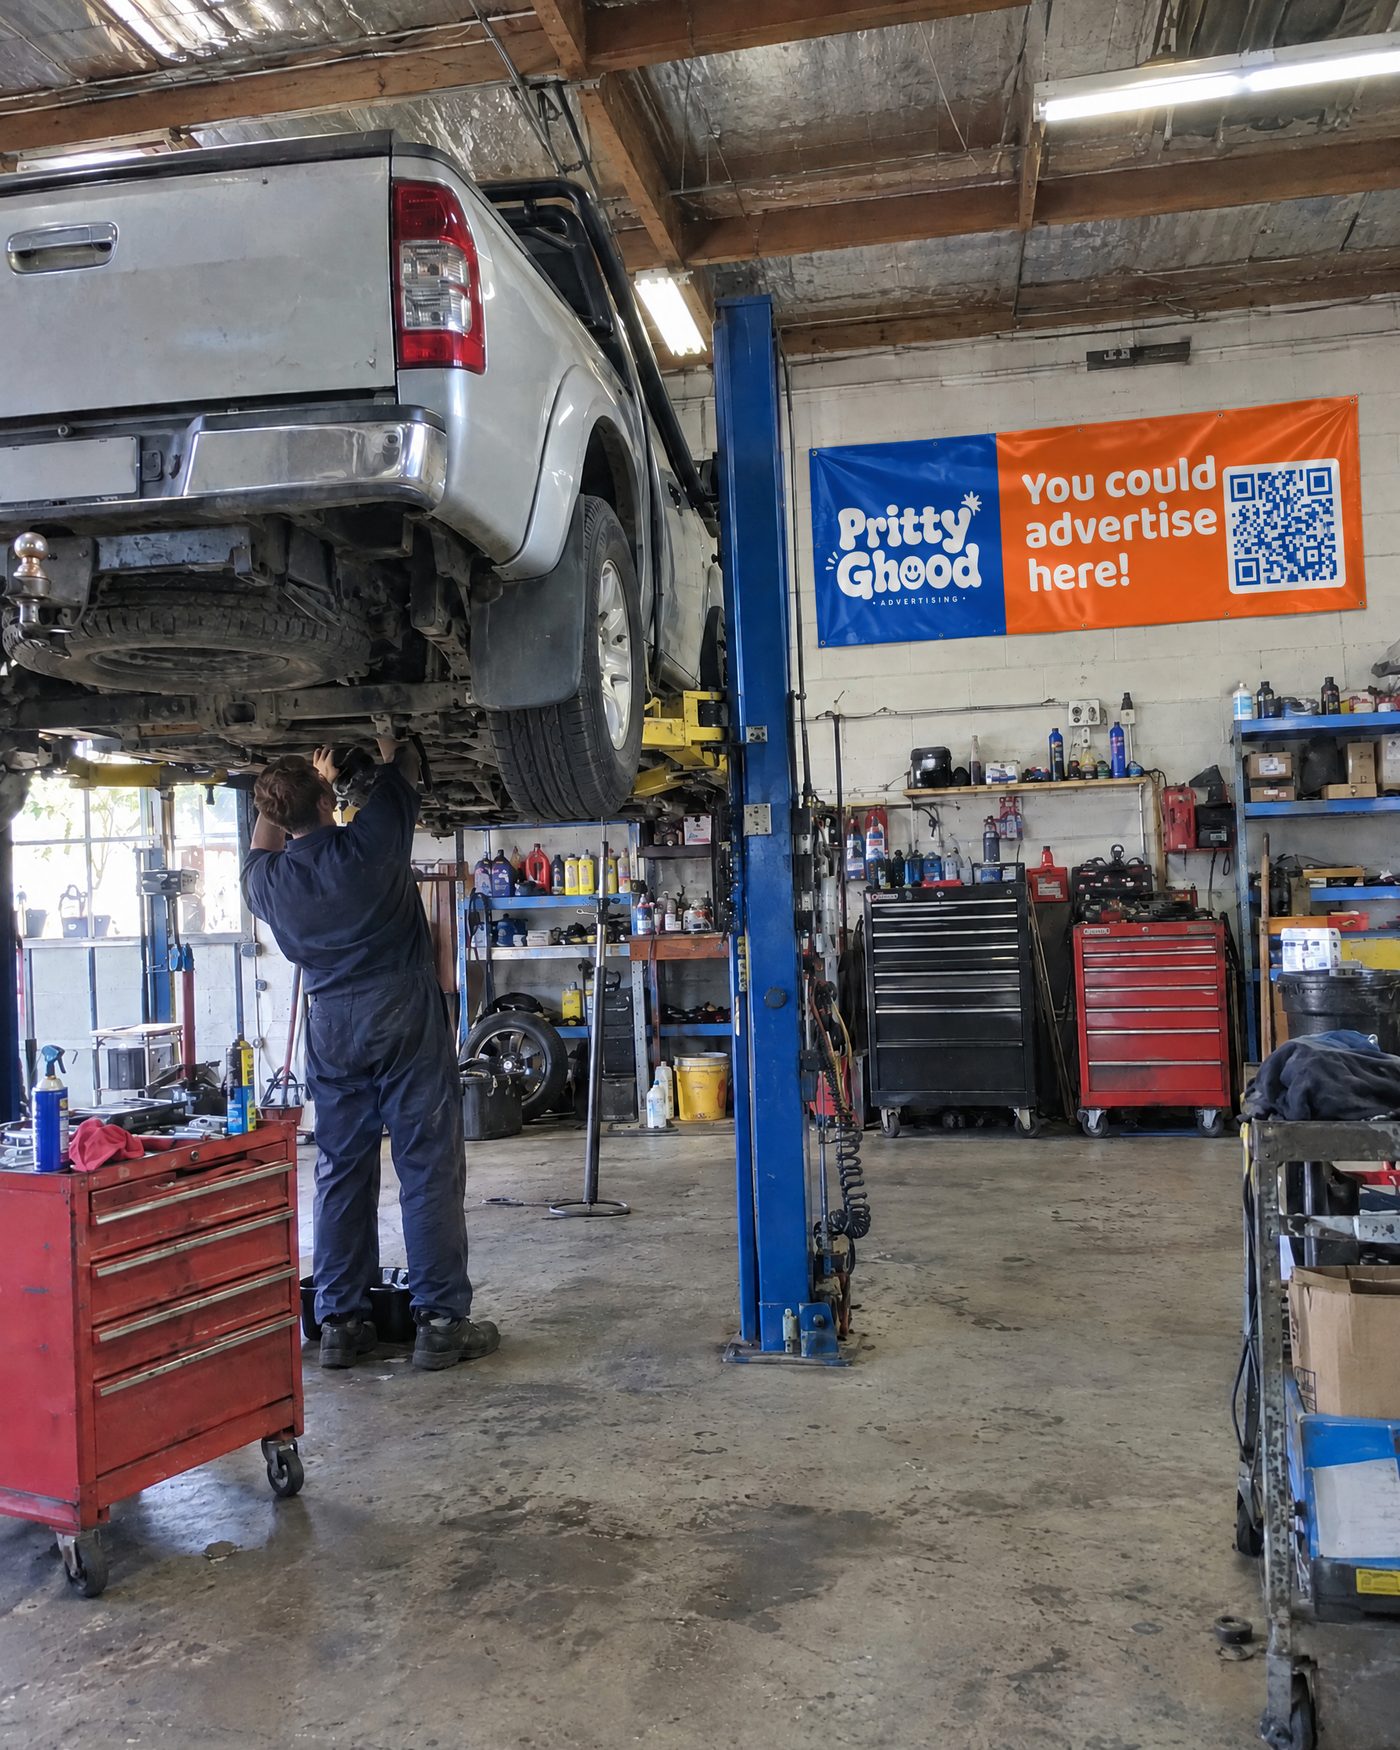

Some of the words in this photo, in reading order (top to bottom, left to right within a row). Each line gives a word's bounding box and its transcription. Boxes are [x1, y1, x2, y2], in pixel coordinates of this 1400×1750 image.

[1022, 473, 1095, 504] You
[1106, 455, 1217, 498] could
[838, 505, 971, 554] Pritty
[1025, 501, 1218, 548] advertise
[836, 543, 982, 600] Ghood
[1028, 552, 1131, 593] here!
[880, 596, 958, 606] ADVERTISING
